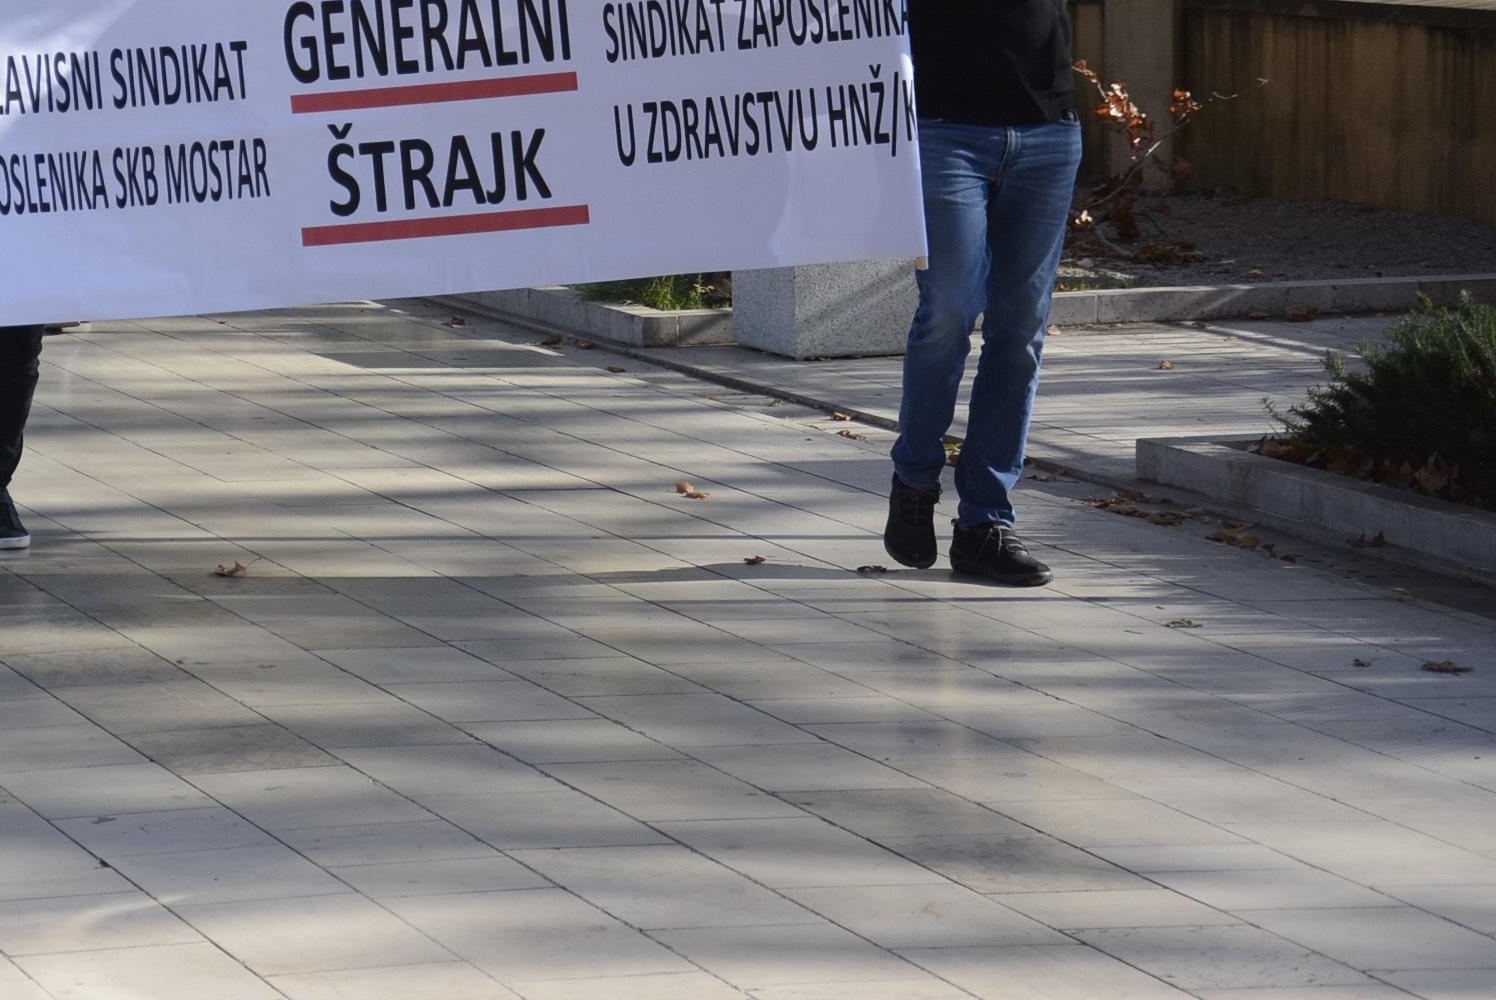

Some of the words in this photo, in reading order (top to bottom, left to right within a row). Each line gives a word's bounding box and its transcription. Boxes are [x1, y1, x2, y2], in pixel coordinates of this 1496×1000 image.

[110, 40, 248, 110] SINDIKAT
[614, 103, 638, 167] U
[644, 87, 818, 164] ZDRAVSTVU
[112, 145, 158, 210] SKB
[165, 137, 271, 204] MOSTAR
[327, 122, 553, 217] ŠTRAJK
